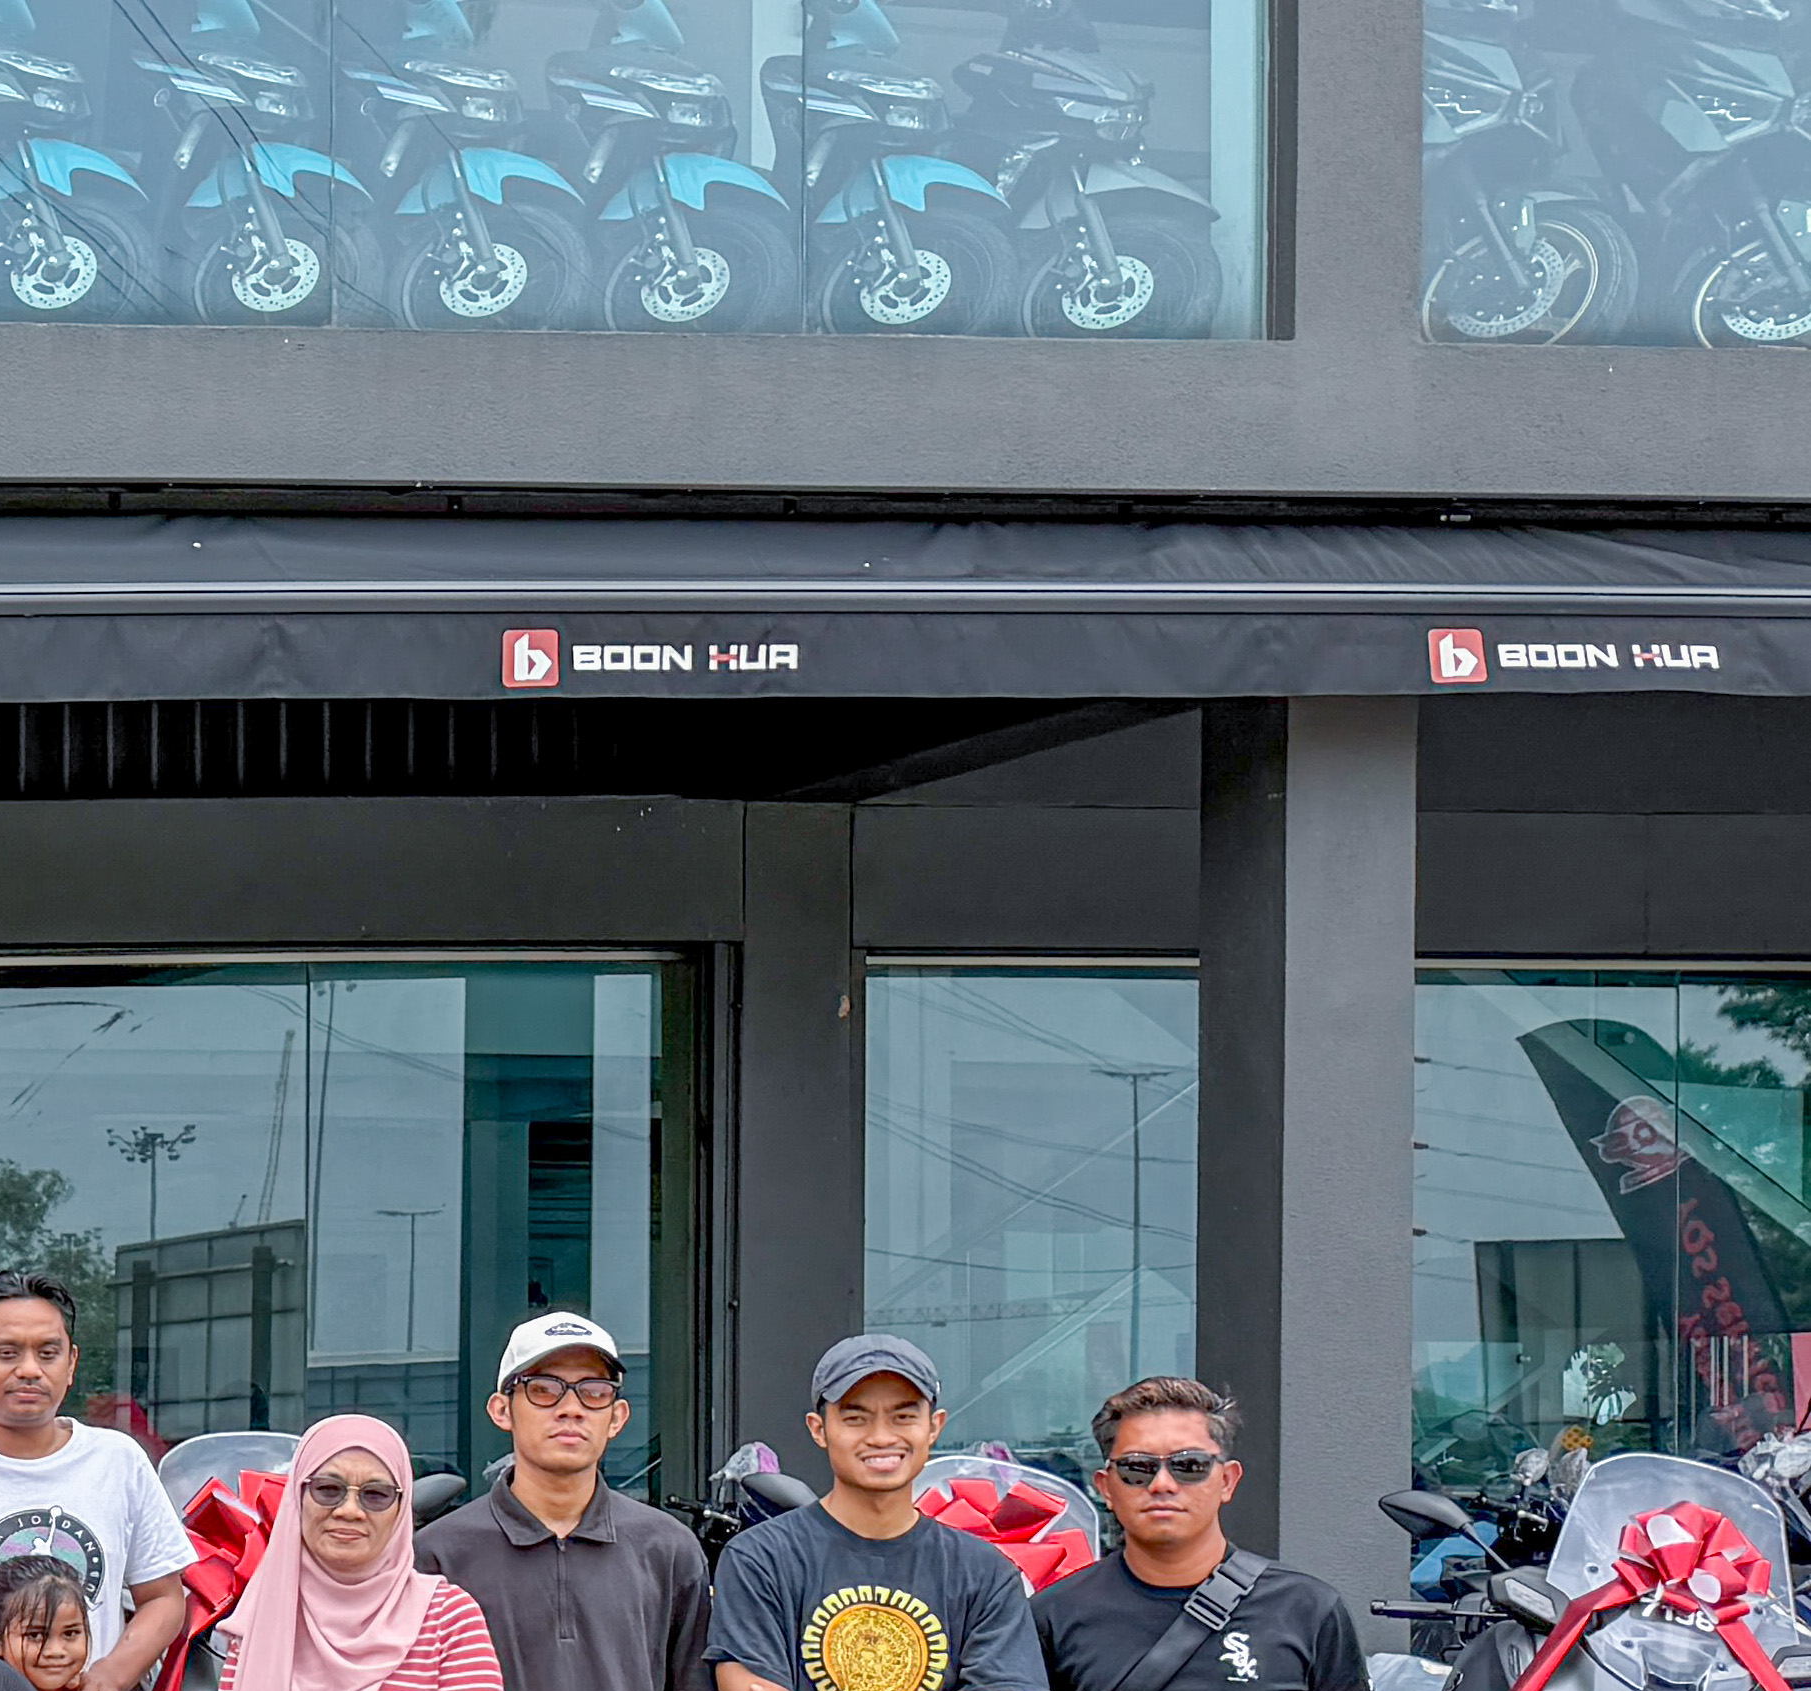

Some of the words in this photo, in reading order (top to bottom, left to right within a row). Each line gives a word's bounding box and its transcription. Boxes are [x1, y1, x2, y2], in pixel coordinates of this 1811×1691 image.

[572, 645, 693, 671] BOON
[709, 644, 799, 671] HUA
[1497, 644, 1619, 668] BOON
[1632, 644, 1720, 669] HUA
